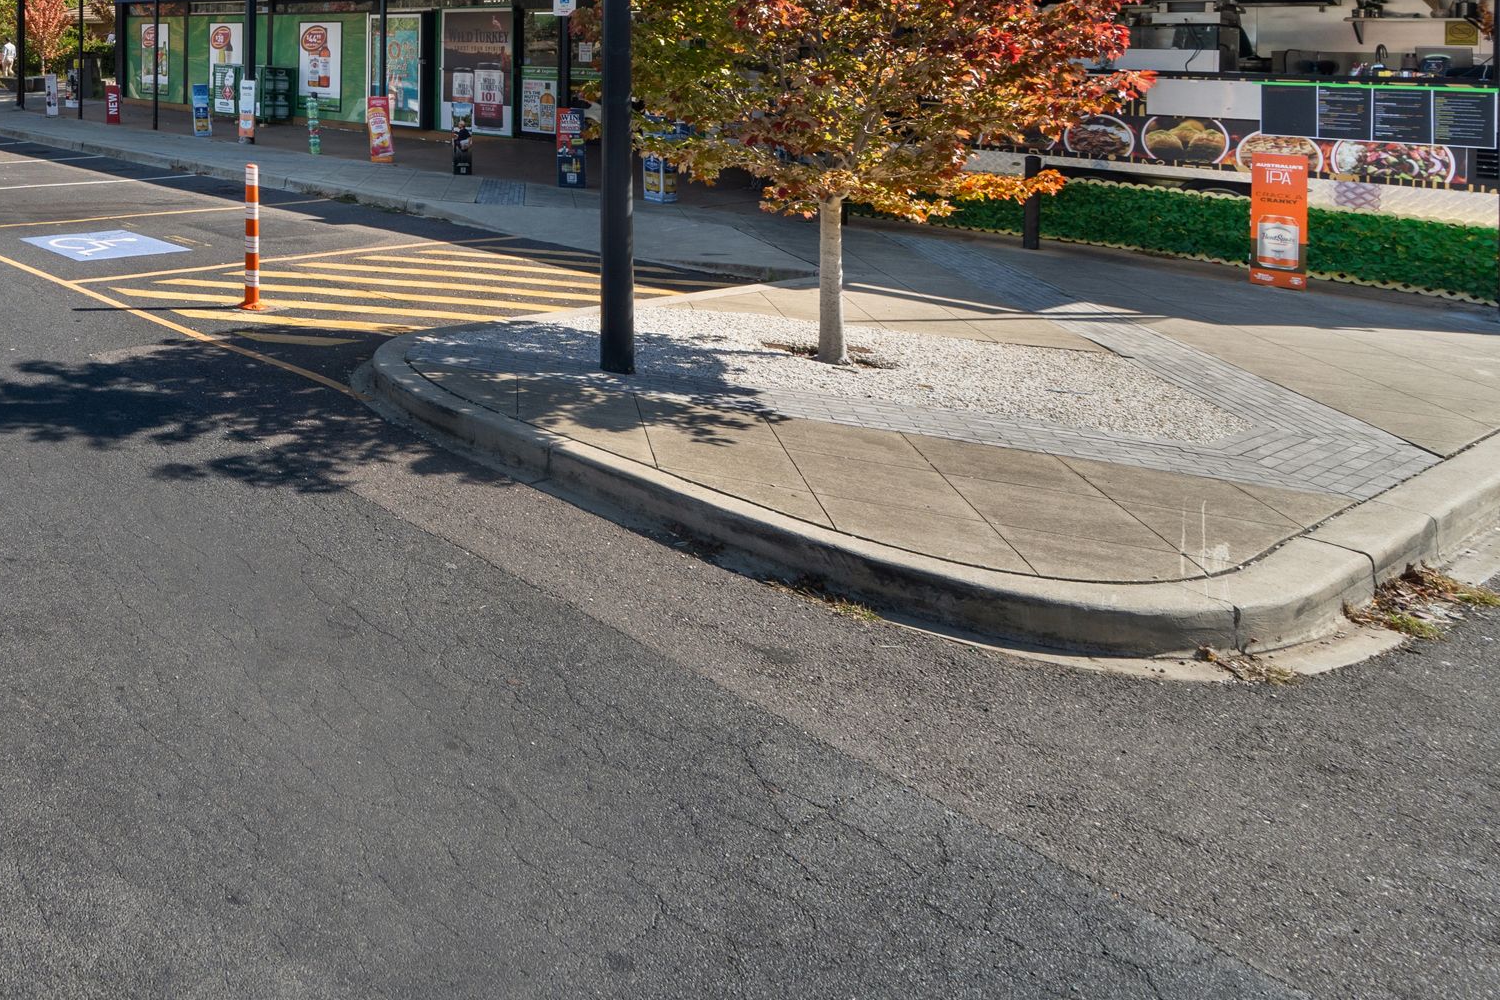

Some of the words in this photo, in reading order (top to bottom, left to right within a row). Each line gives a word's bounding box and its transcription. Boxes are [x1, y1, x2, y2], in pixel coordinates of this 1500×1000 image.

[448, 29, 473, 43] WILD
[474, 29, 509, 44] TURKEY
[481, 92, 496, 102] 101
[108, 93, 118, 115] NEW
[1255, 162, 1304, 170] AUSTRALIA'S
[1266, 171, 1292, 185] IPA
[1260, 197, 1297, 205] CRANKY
